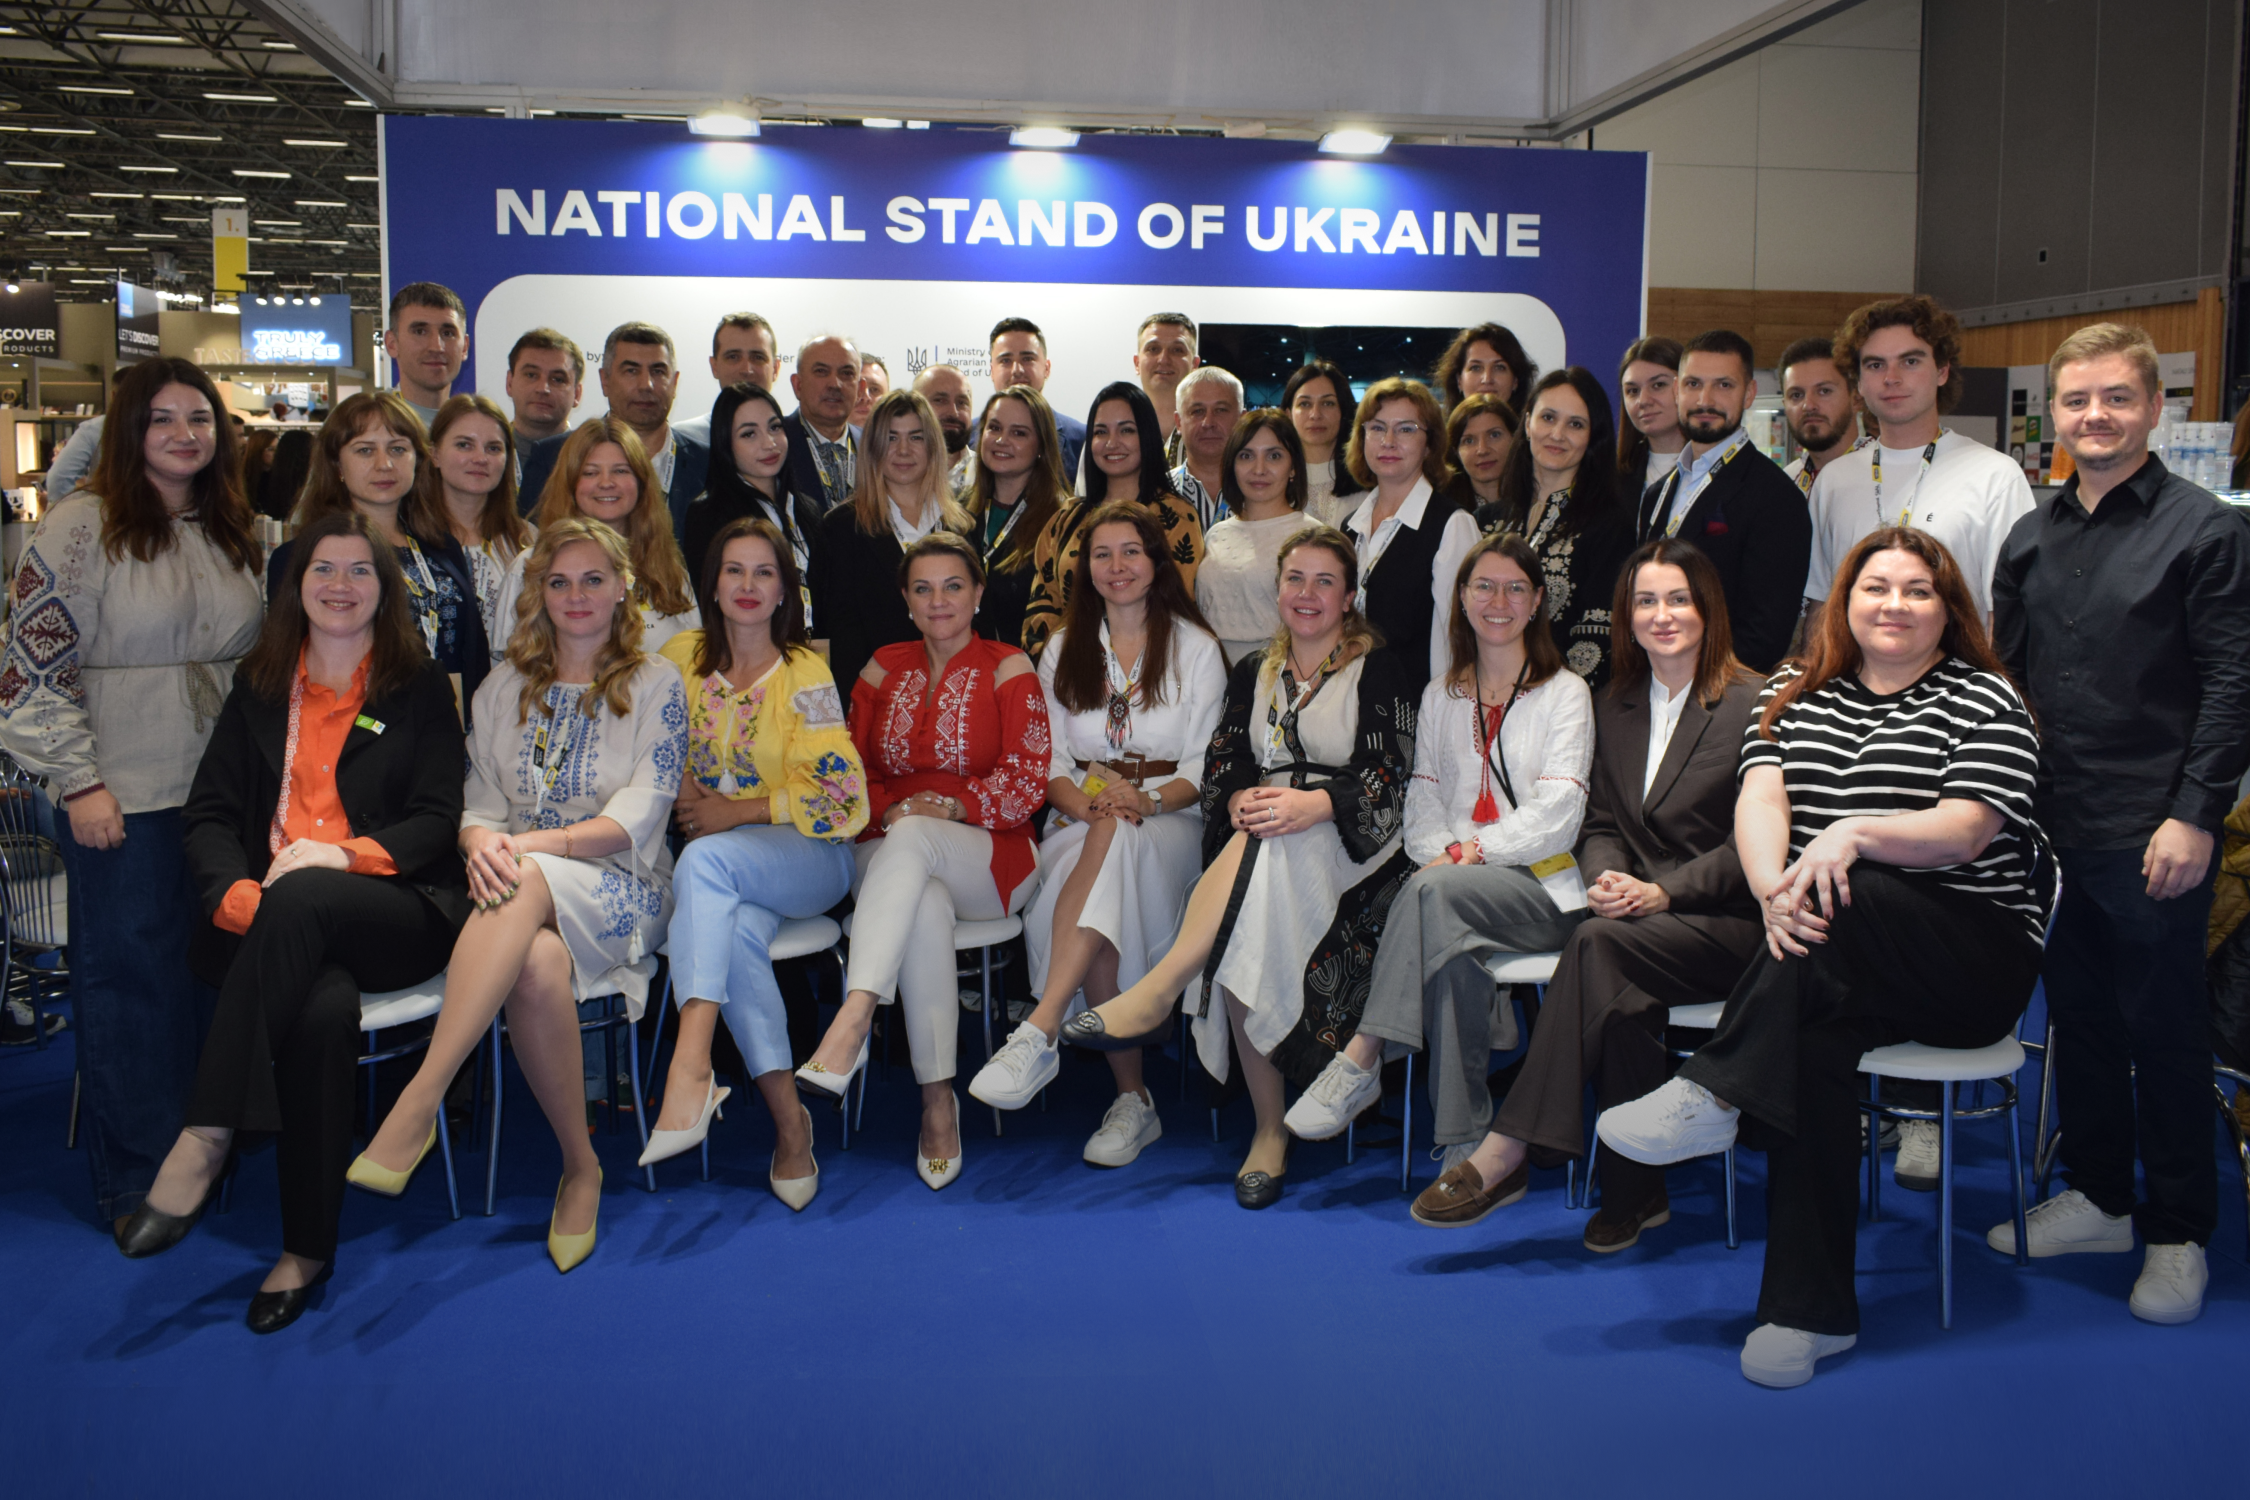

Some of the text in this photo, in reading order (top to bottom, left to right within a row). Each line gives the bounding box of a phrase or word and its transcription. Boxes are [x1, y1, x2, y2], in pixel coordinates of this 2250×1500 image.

[496, 189, 1541, 258] NATIONAL STAND OF UKRAINE
[133, 331, 160, 347] DISCOVER
[253, 331, 325, 345] TRULY
[3, 344, 55, 353] RODUCTS
[254, 345, 339, 359] GREECE
[946, 347, 985, 358] Ministry
[194, 347, 252, 366] TASTE
[946, 358, 987, 368] Agrarian
